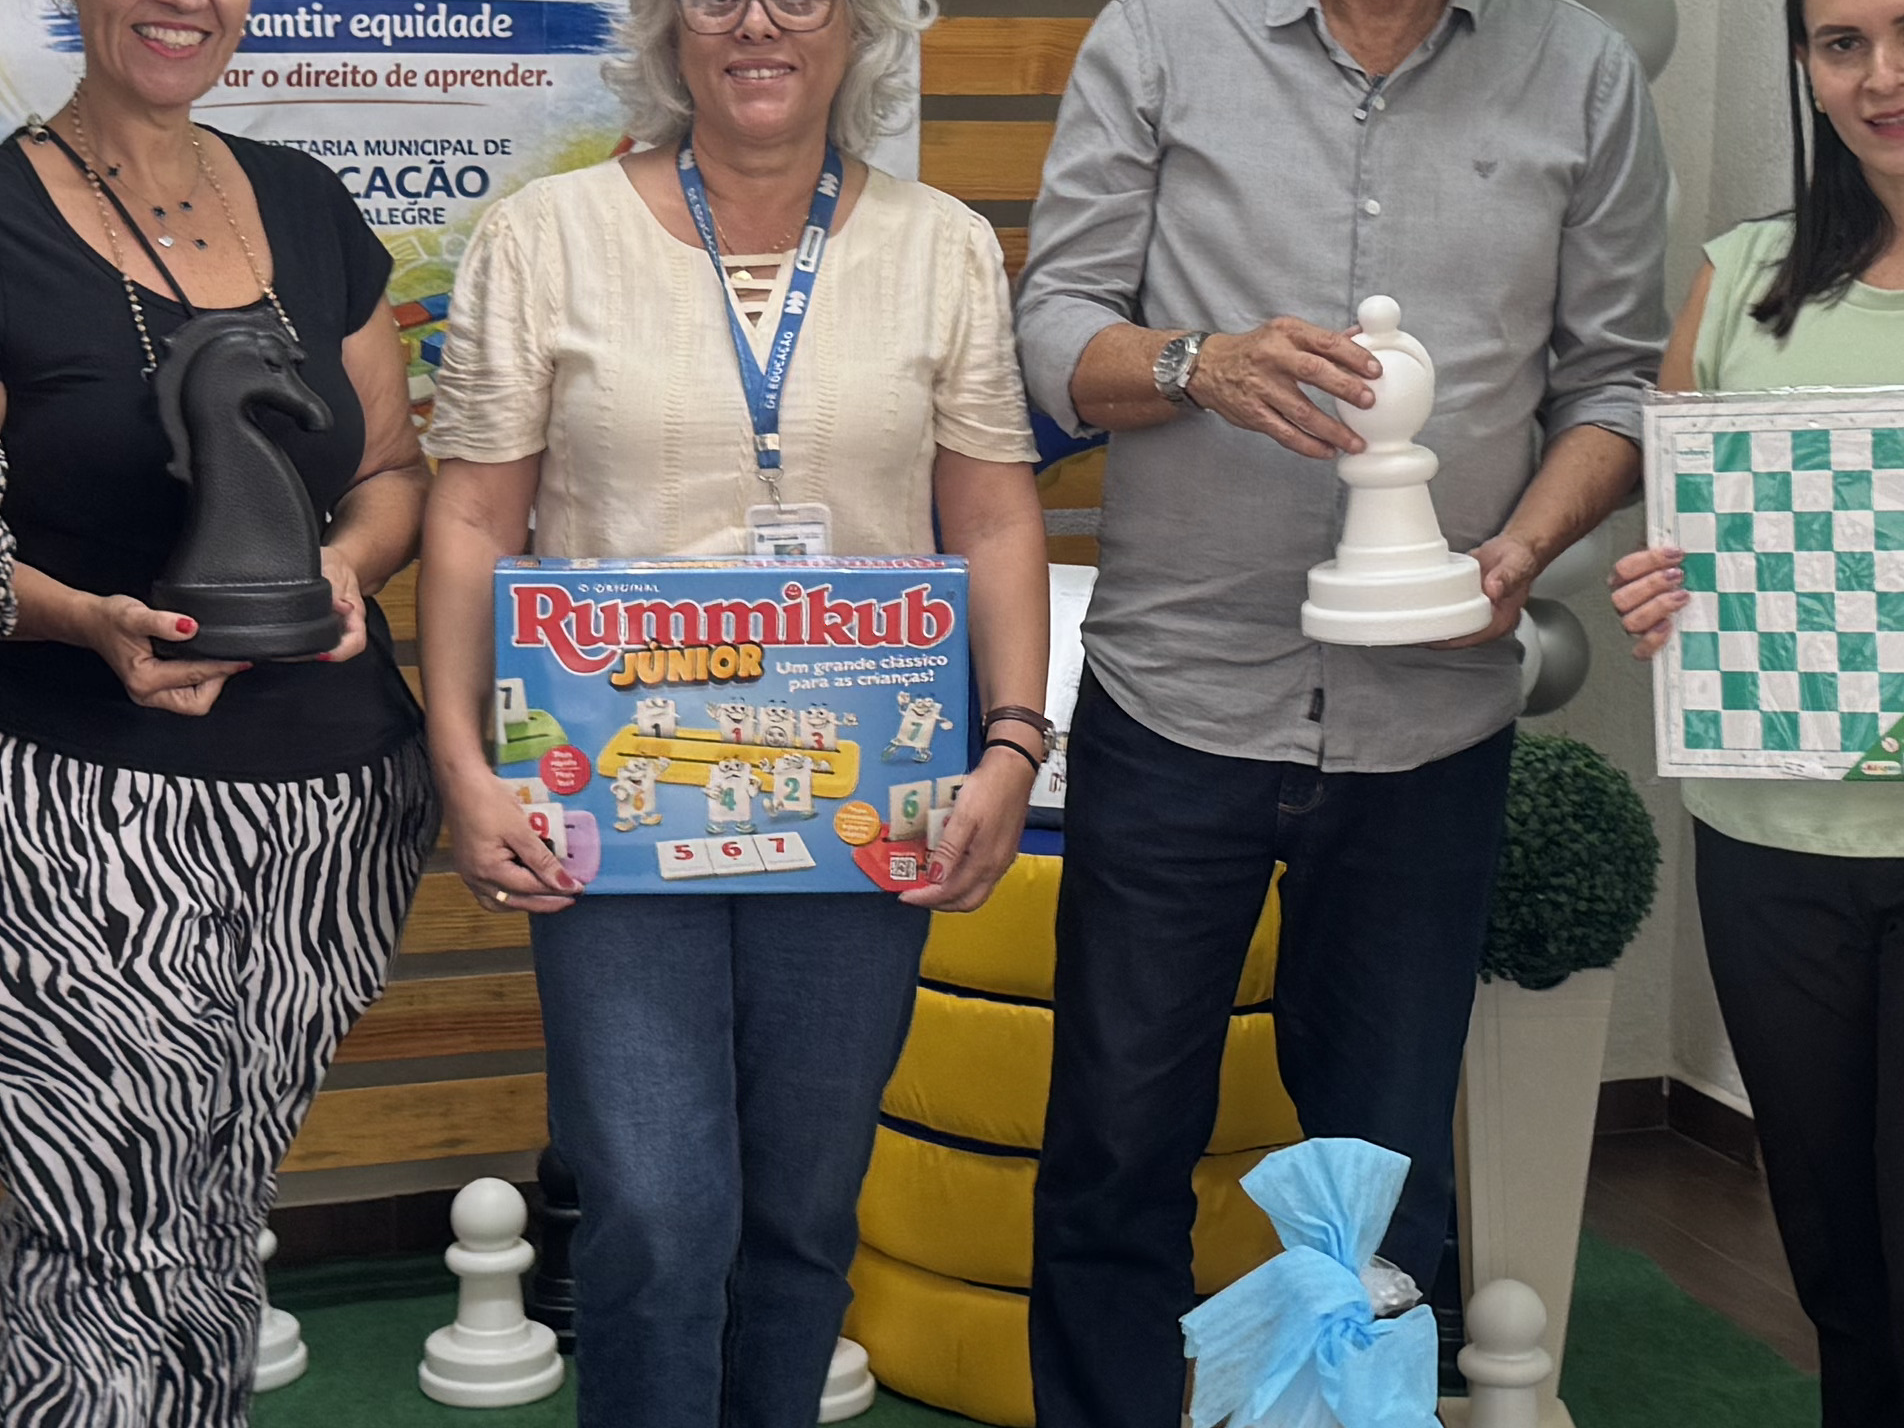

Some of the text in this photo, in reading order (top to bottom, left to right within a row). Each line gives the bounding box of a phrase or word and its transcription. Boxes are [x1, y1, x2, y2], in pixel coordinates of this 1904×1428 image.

[349, 3, 514, 47] equidade
[261, 67, 279, 88] o
[285, 61, 379, 88] direito
[384, 62, 418, 88] de
[423, 62, 554, 93] aprender.
[363, 138, 479, 157] MUNICIPAL
[483, 138, 513, 155] DE
[339, 158, 491, 205] CAÇÃO
[511, 579, 956, 675] Rummikub
[609, 639, 764, 688] JÚNIOR
[775, 652, 949, 677] Um grande clássico
[788, 668, 936, 693] para as crianças!
[731, 727, 743, 744] 1
[811, 731, 825, 750] 3
[908, 721, 923, 742] 7
[783, 777, 801, 802] 2
[902, 790, 920, 818] 6
[673, 837, 786, 861] 5 6 7
